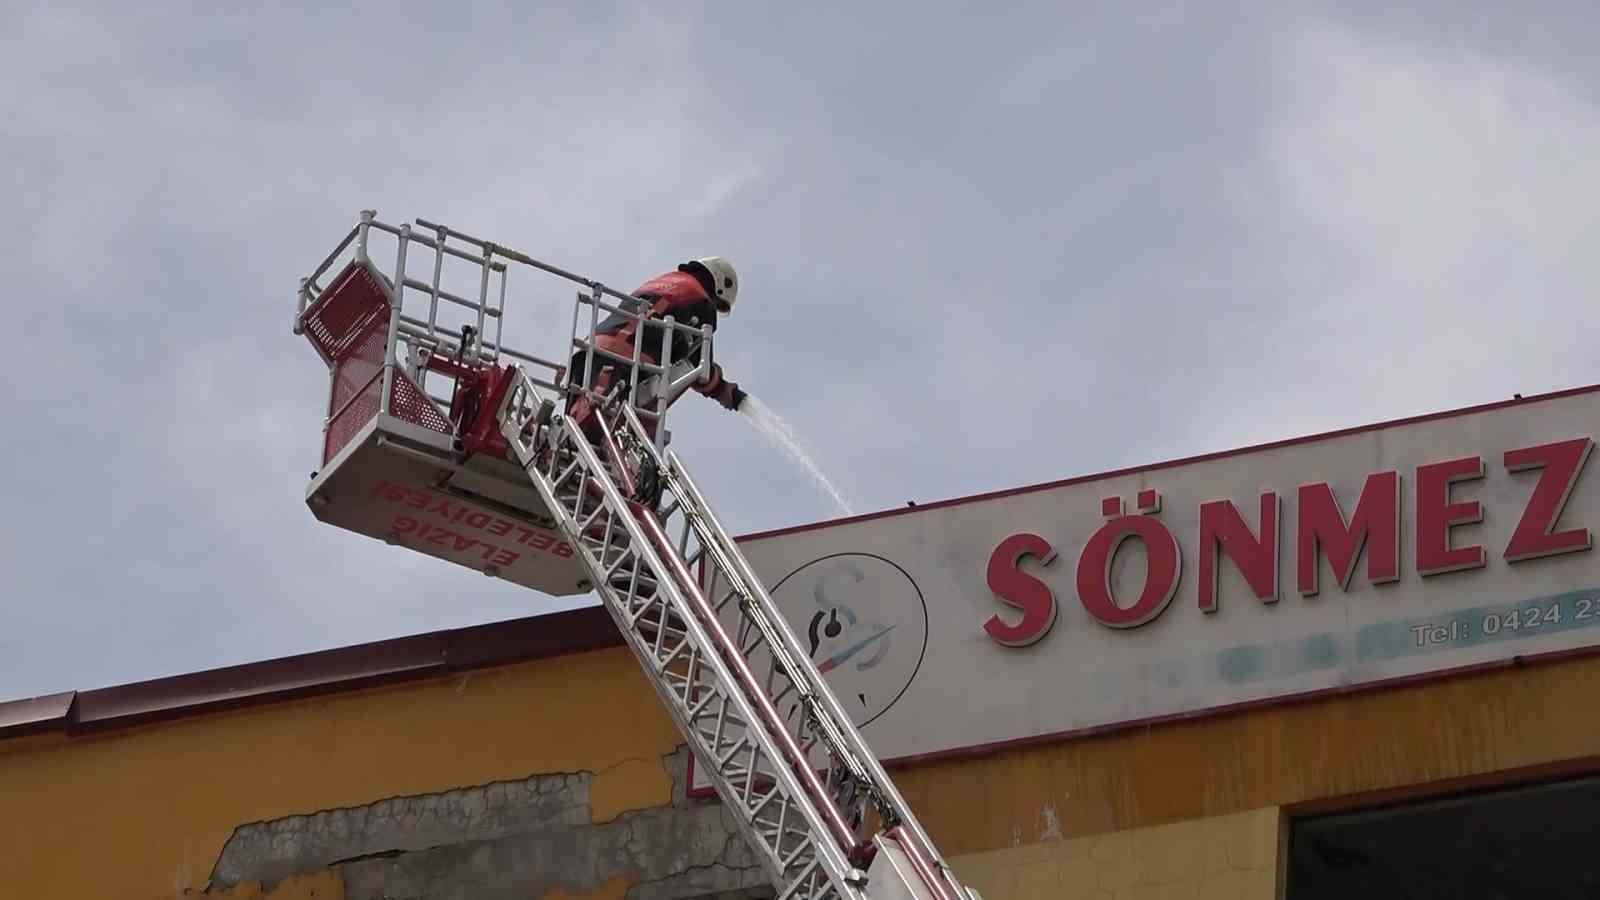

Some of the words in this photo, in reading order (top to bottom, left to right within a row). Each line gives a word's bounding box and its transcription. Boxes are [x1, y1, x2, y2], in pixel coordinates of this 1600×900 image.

[983, 437, 1595, 648] SÖNMEZ
[1410, 622, 1472, 648] Tel:
[1482, 603, 1562, 634] 0424
